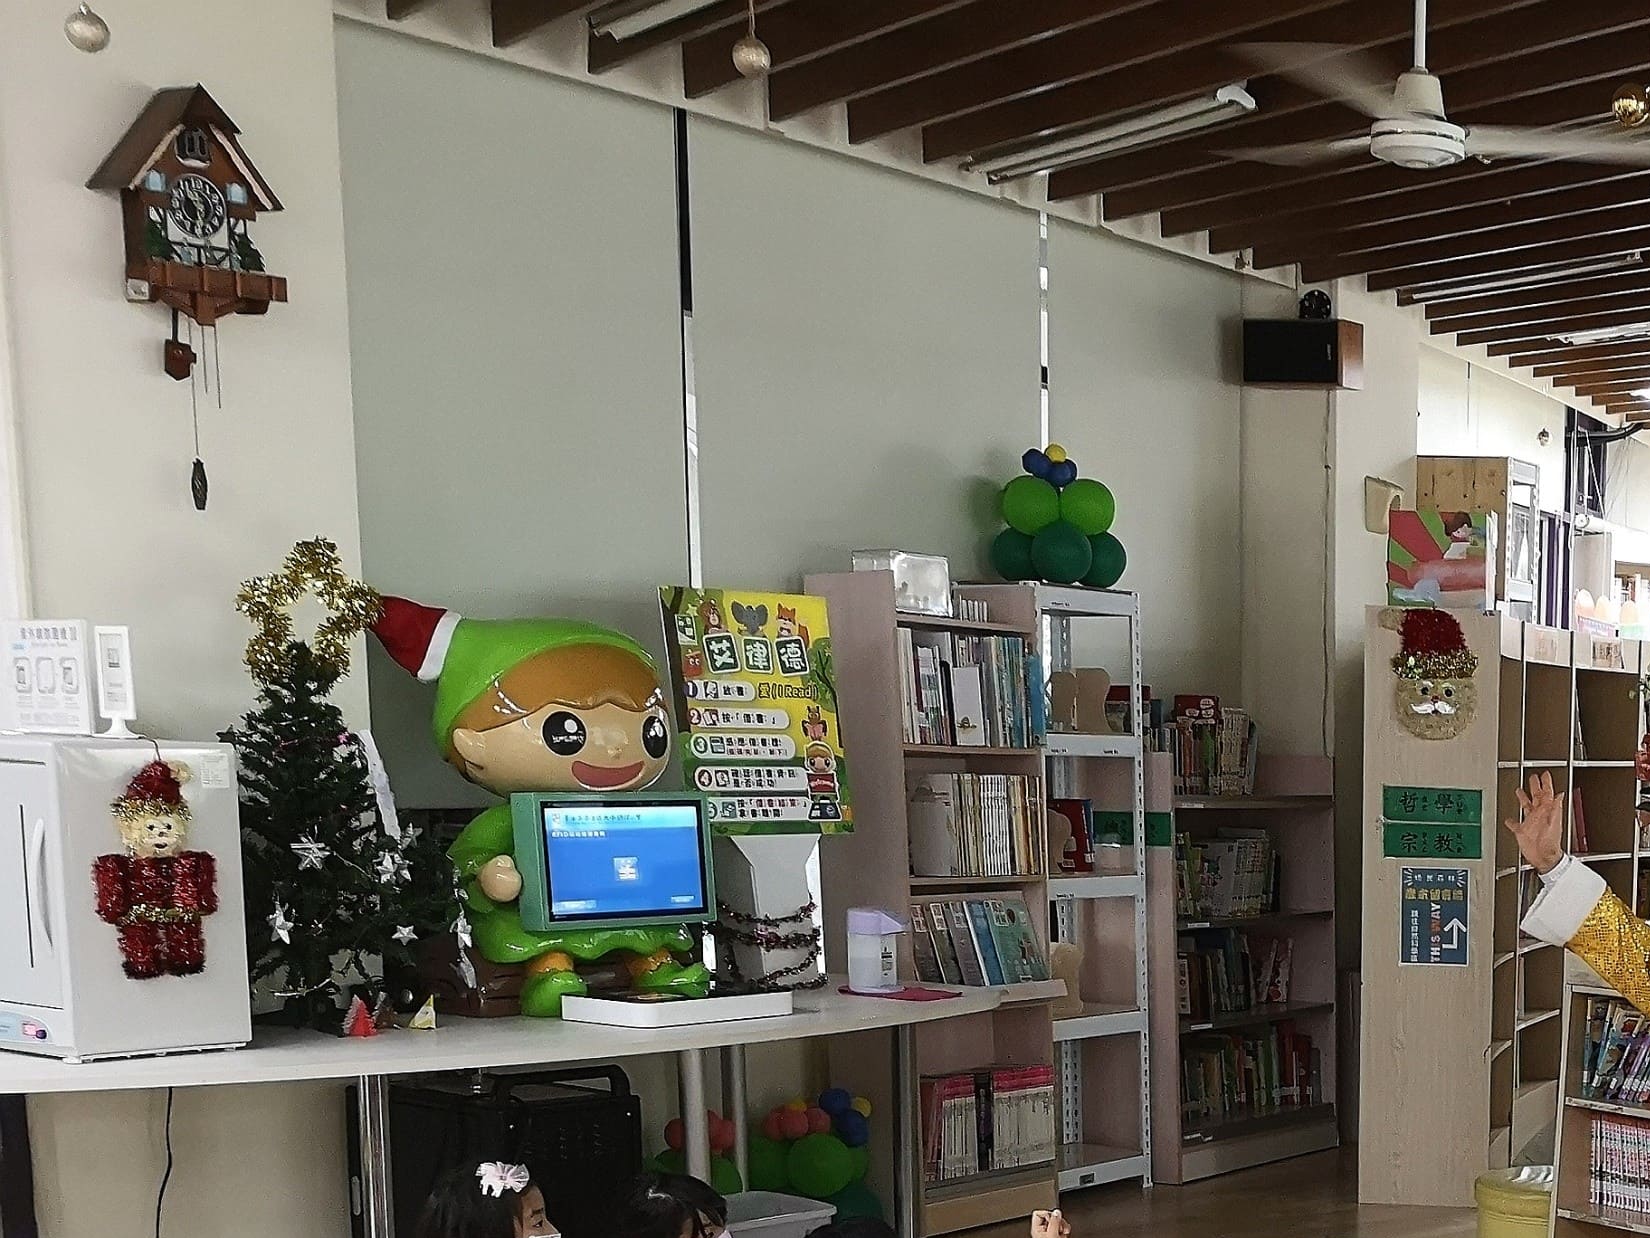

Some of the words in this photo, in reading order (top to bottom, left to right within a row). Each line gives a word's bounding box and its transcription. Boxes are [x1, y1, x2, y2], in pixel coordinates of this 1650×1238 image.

[709, 638, 806, 669] 艾律德
[1400, 792, 1467, 815] 哲學
[1401, 832, 1464, 854] 宗教
